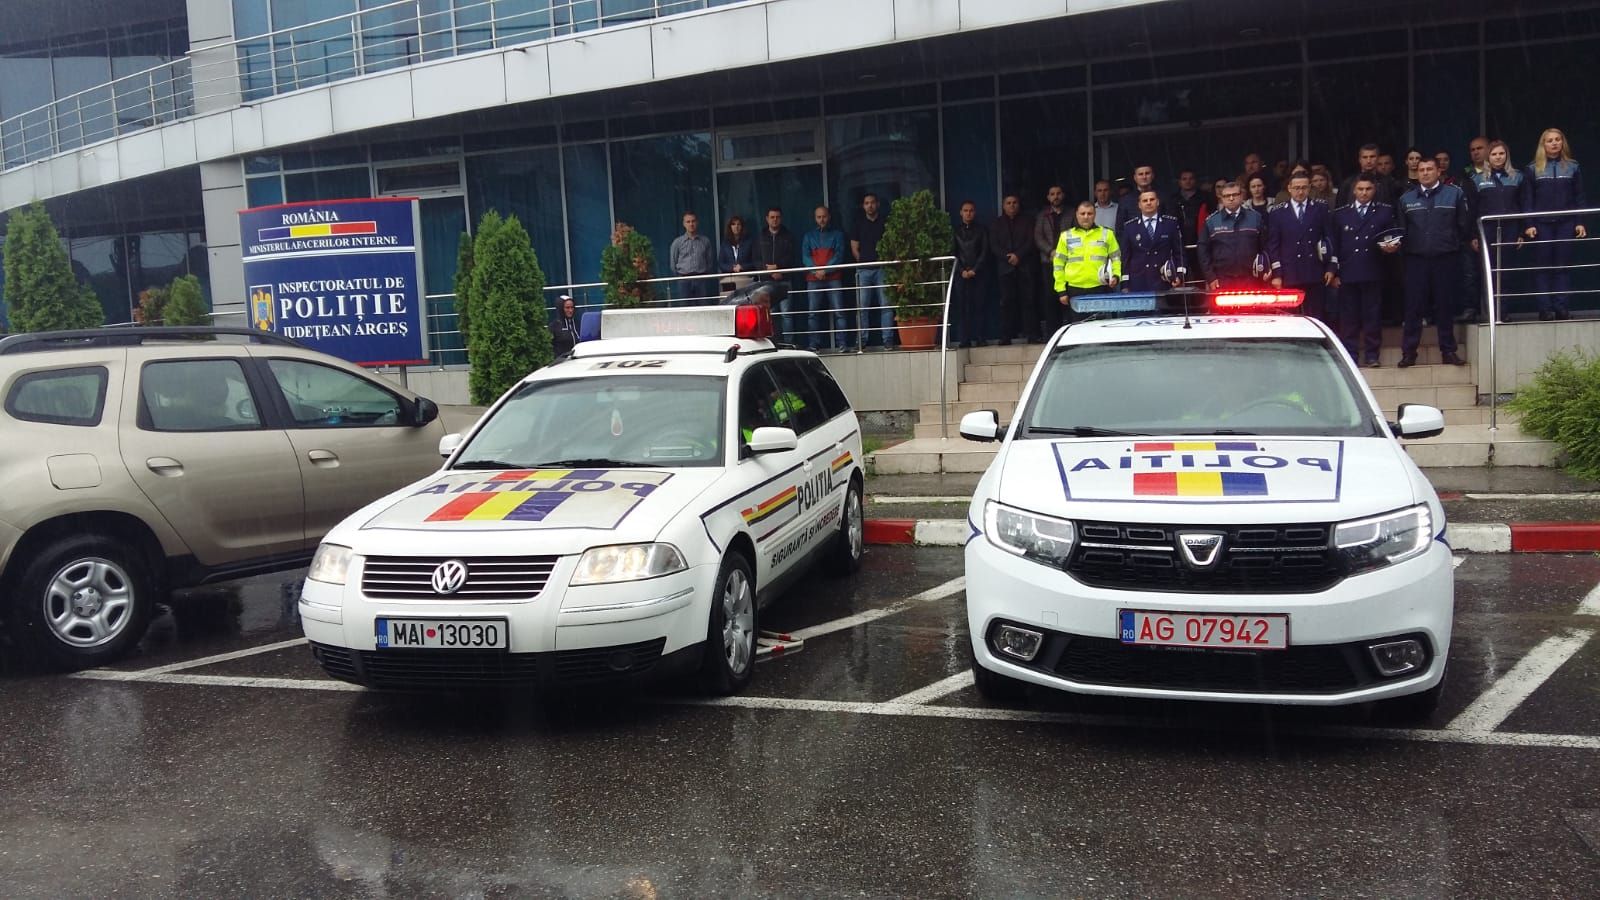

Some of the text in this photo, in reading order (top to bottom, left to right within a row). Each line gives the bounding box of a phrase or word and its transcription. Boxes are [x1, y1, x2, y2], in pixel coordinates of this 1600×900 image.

[282, 209, 339, 225] ROMÂNIA
[249, 236, 398, 254] MINISTERUL AFACERILOR INTERNE
[279, 277, 405, 293] INSPECTORATUL DE
[597, 360, 667, 369] 102
[393, 623, 425, 645] MAI
[437, 624, 498, 647] 13030
[1122, 616, 1269, 644] RO AG 07942
